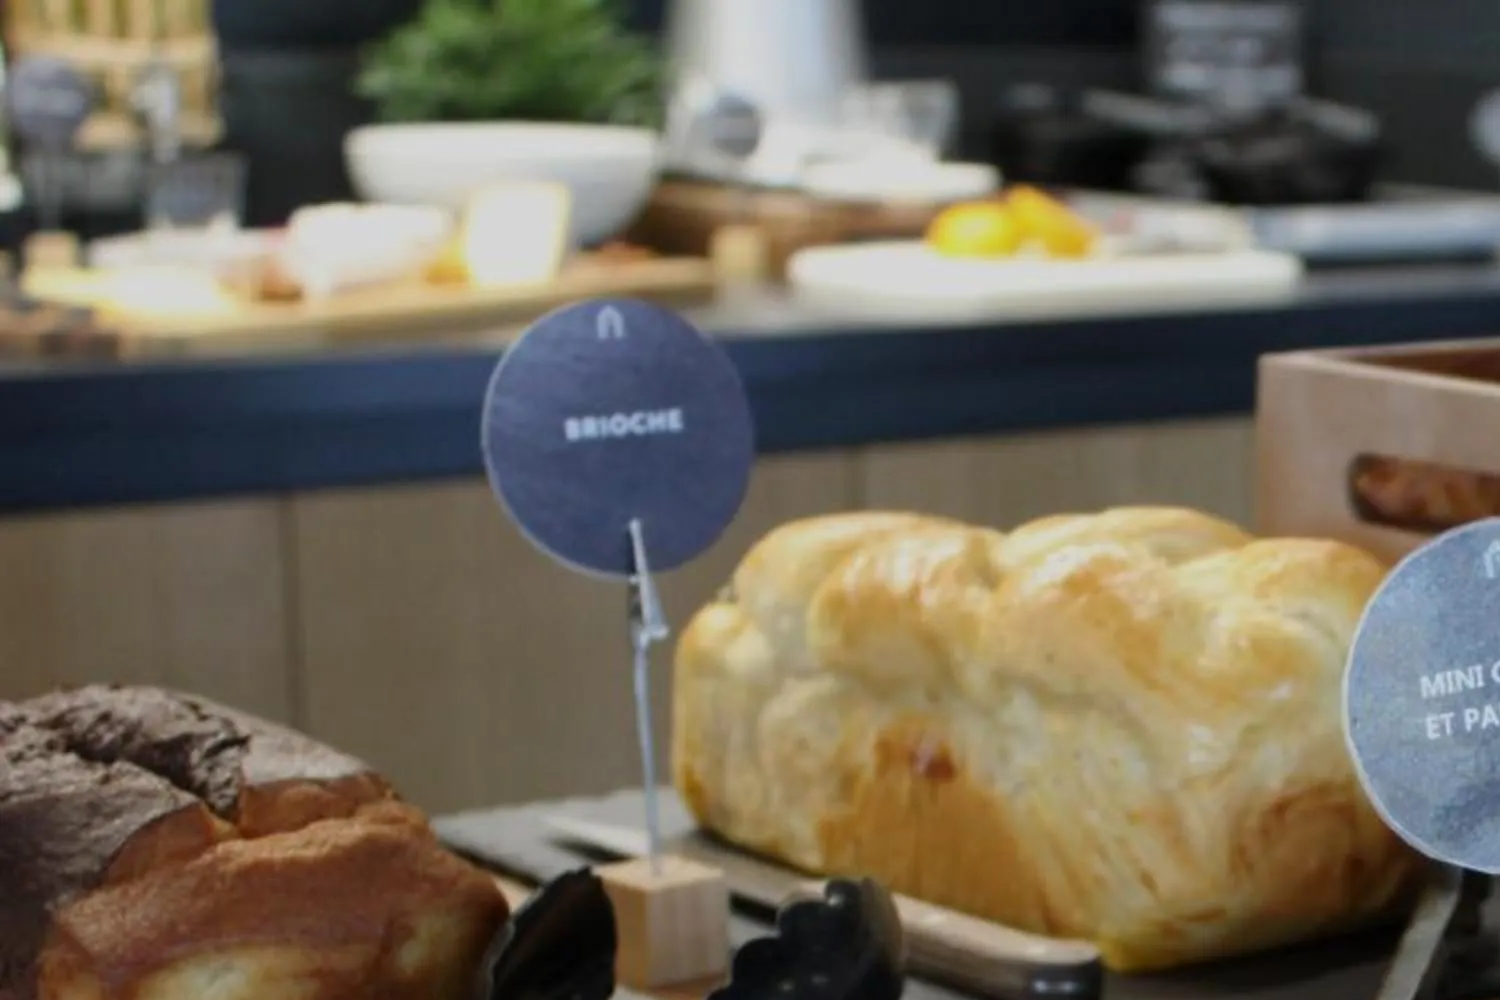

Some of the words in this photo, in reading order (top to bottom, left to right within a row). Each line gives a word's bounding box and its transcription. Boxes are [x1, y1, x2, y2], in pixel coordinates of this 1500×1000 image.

[565, 408, 683, 440] BRIOCHE
[1420, 663, 1484, 698] MINI
[1426, 712, 1455, 740] ET
